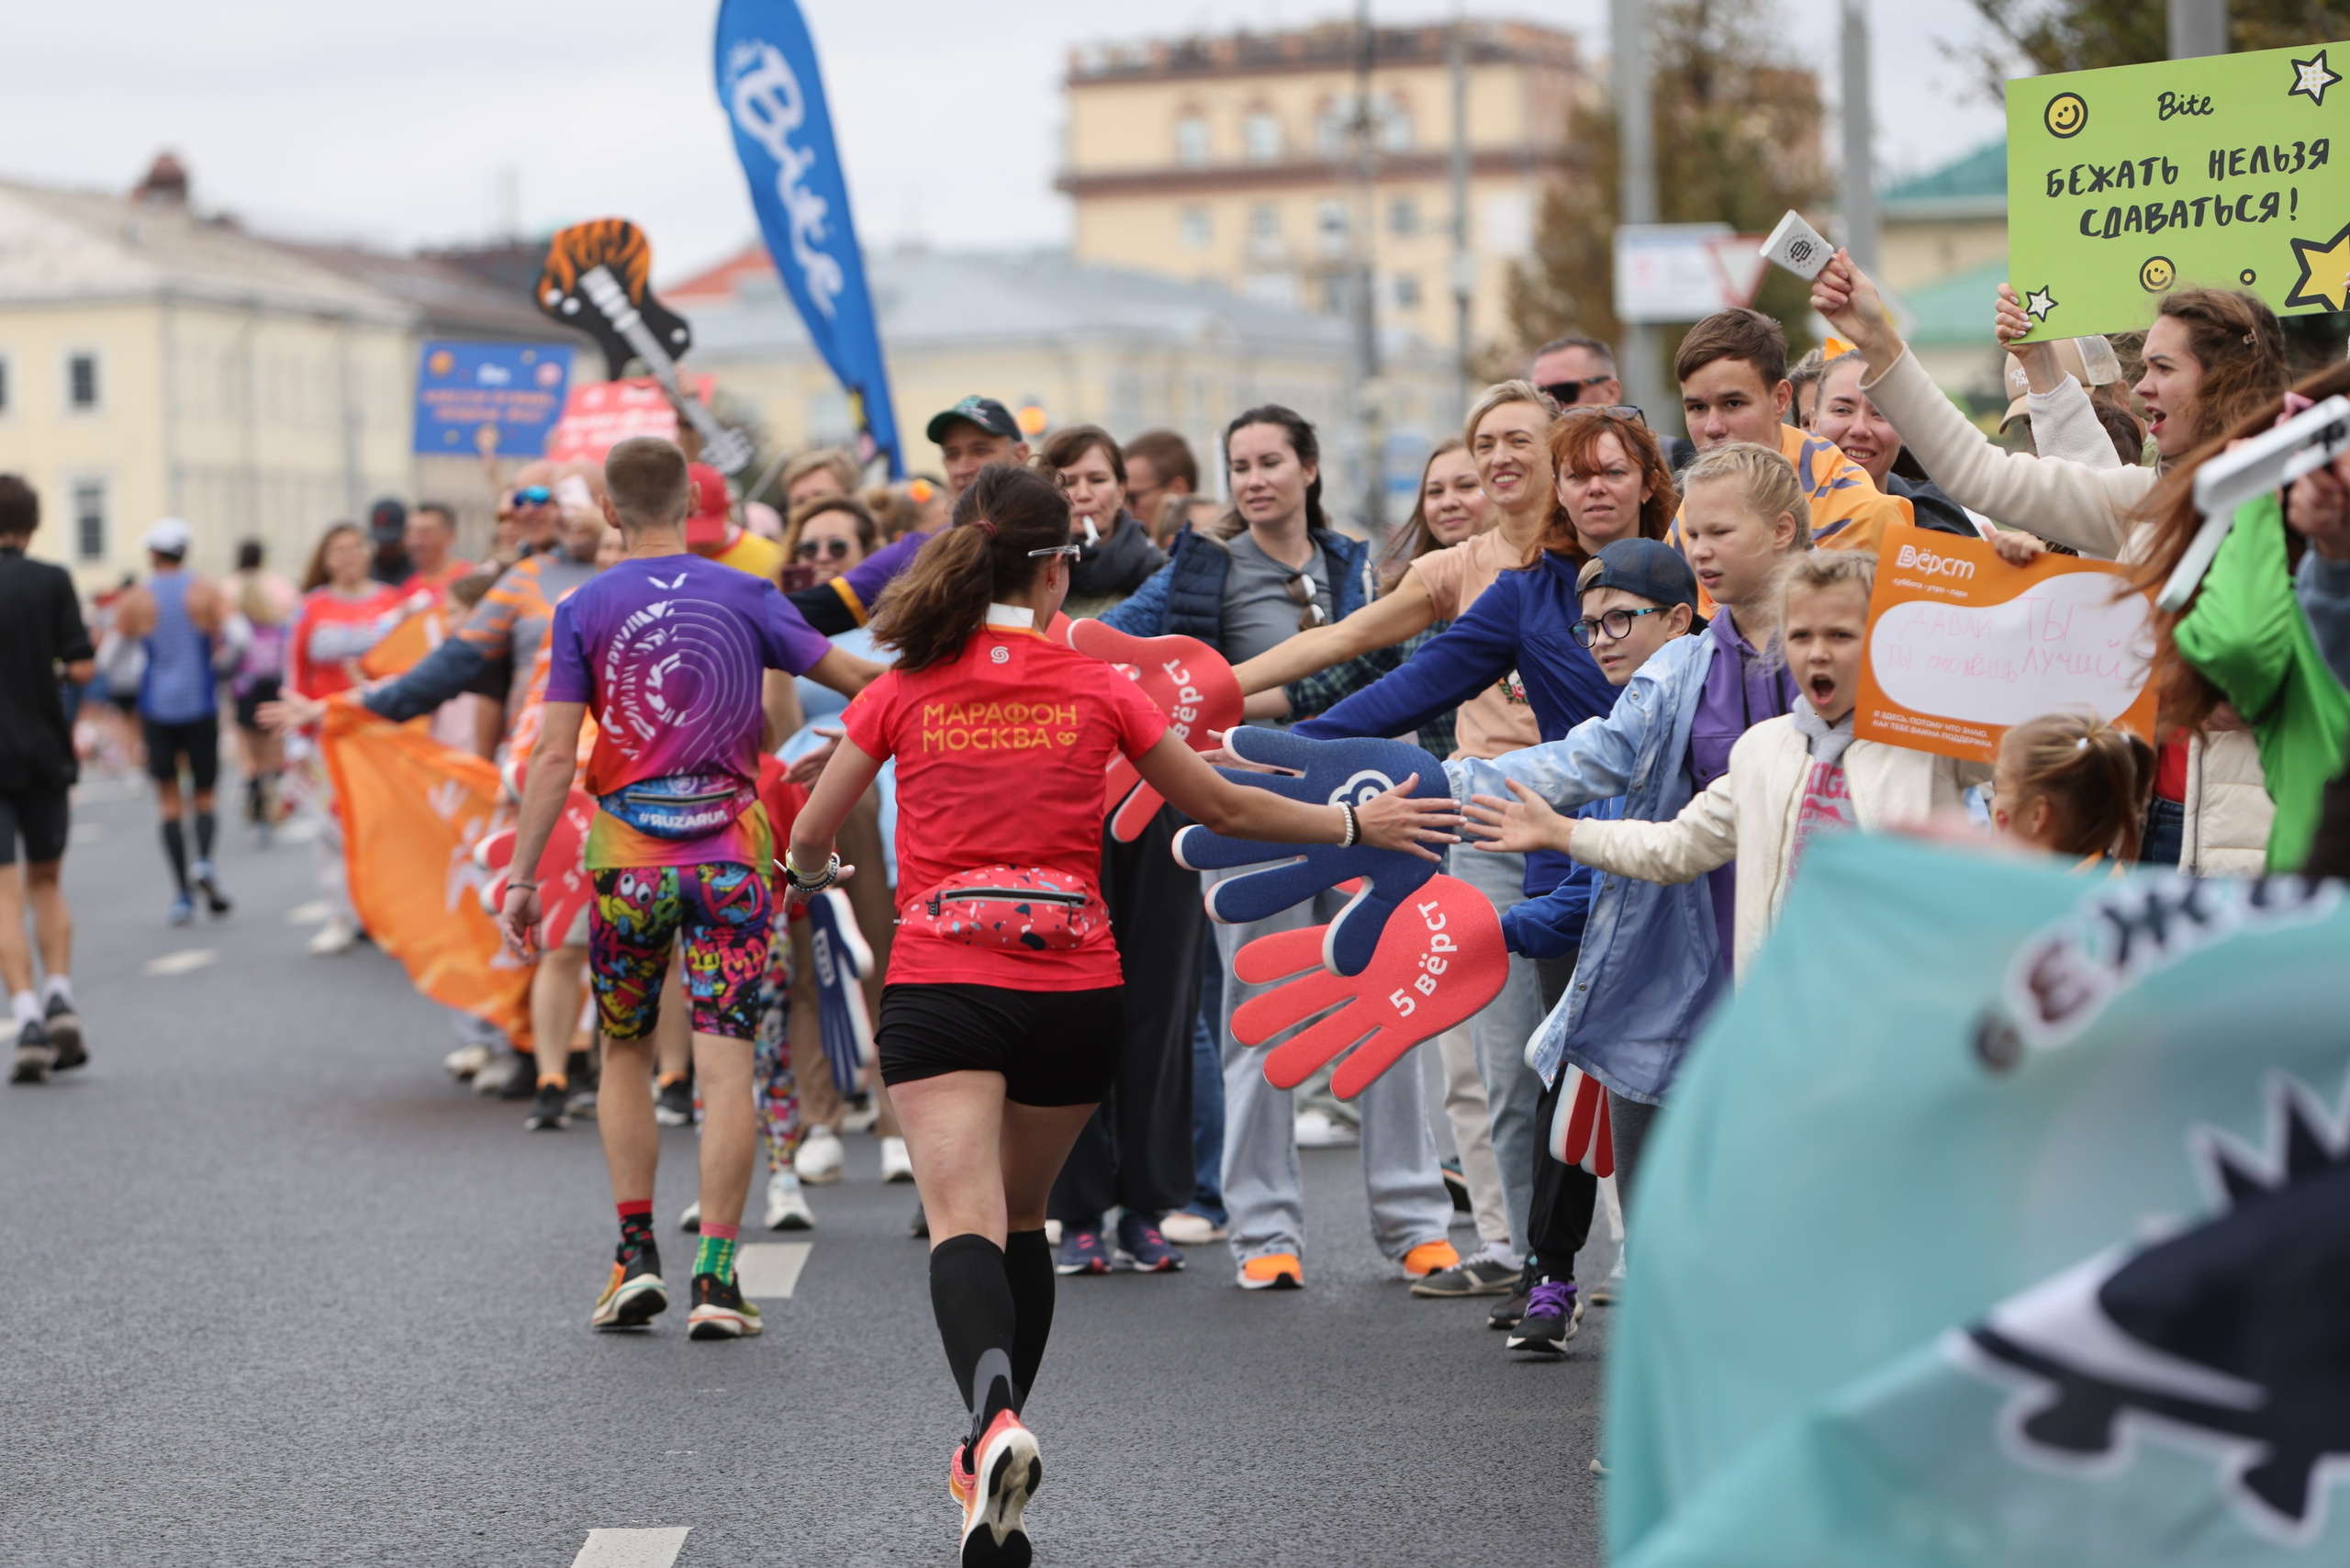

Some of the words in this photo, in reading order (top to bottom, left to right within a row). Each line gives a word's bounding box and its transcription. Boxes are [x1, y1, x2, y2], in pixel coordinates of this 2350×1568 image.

[2157, 91, 2214, 121] Bite
[2046, 156, 2179, 197] БЕЖАТЬ
[2208, 138, 2330, 182] НЕЛЬЗЯ
[2079, 186, 2299, 239] СДАВАТЬСЯ!
[1894, 577, 1923, 589] суббота
[1928, 584, 1945, 594] утро
[1950, 588, 1969, 599] парк
[1900, 606, 1993, 640] ДАВАЙ
[2015, 596, 2075, 642] ТЫ
[1885, 644, 1913, 671] ТЫ
[923, 702, 1077, 726] МАРАФОН
[1162, 658, 1204, 741] вёрст
[1874, 719, 1889, 728] КАК
[1891, 722, 1909, 733] ТЕБЕ
[1911, 725, 1941, 738] ВАЖНА
[1942, 732, 1993, 748] ПОДДЕРЖКА
[1882, 711, 1908, 723] ЗДЕСЬ,
[1909, 716, 1943, 730] ПОТОМУ
[1945, 723, 1961, 733] ЧТО
[1962, 726, 1988, 738] ЗНАЮ,
[923, 728, 1052, 753] МОСКВА
[1388, 988, 1416, 1017] 5
[1414, 900, 1458, 997] вёрст
